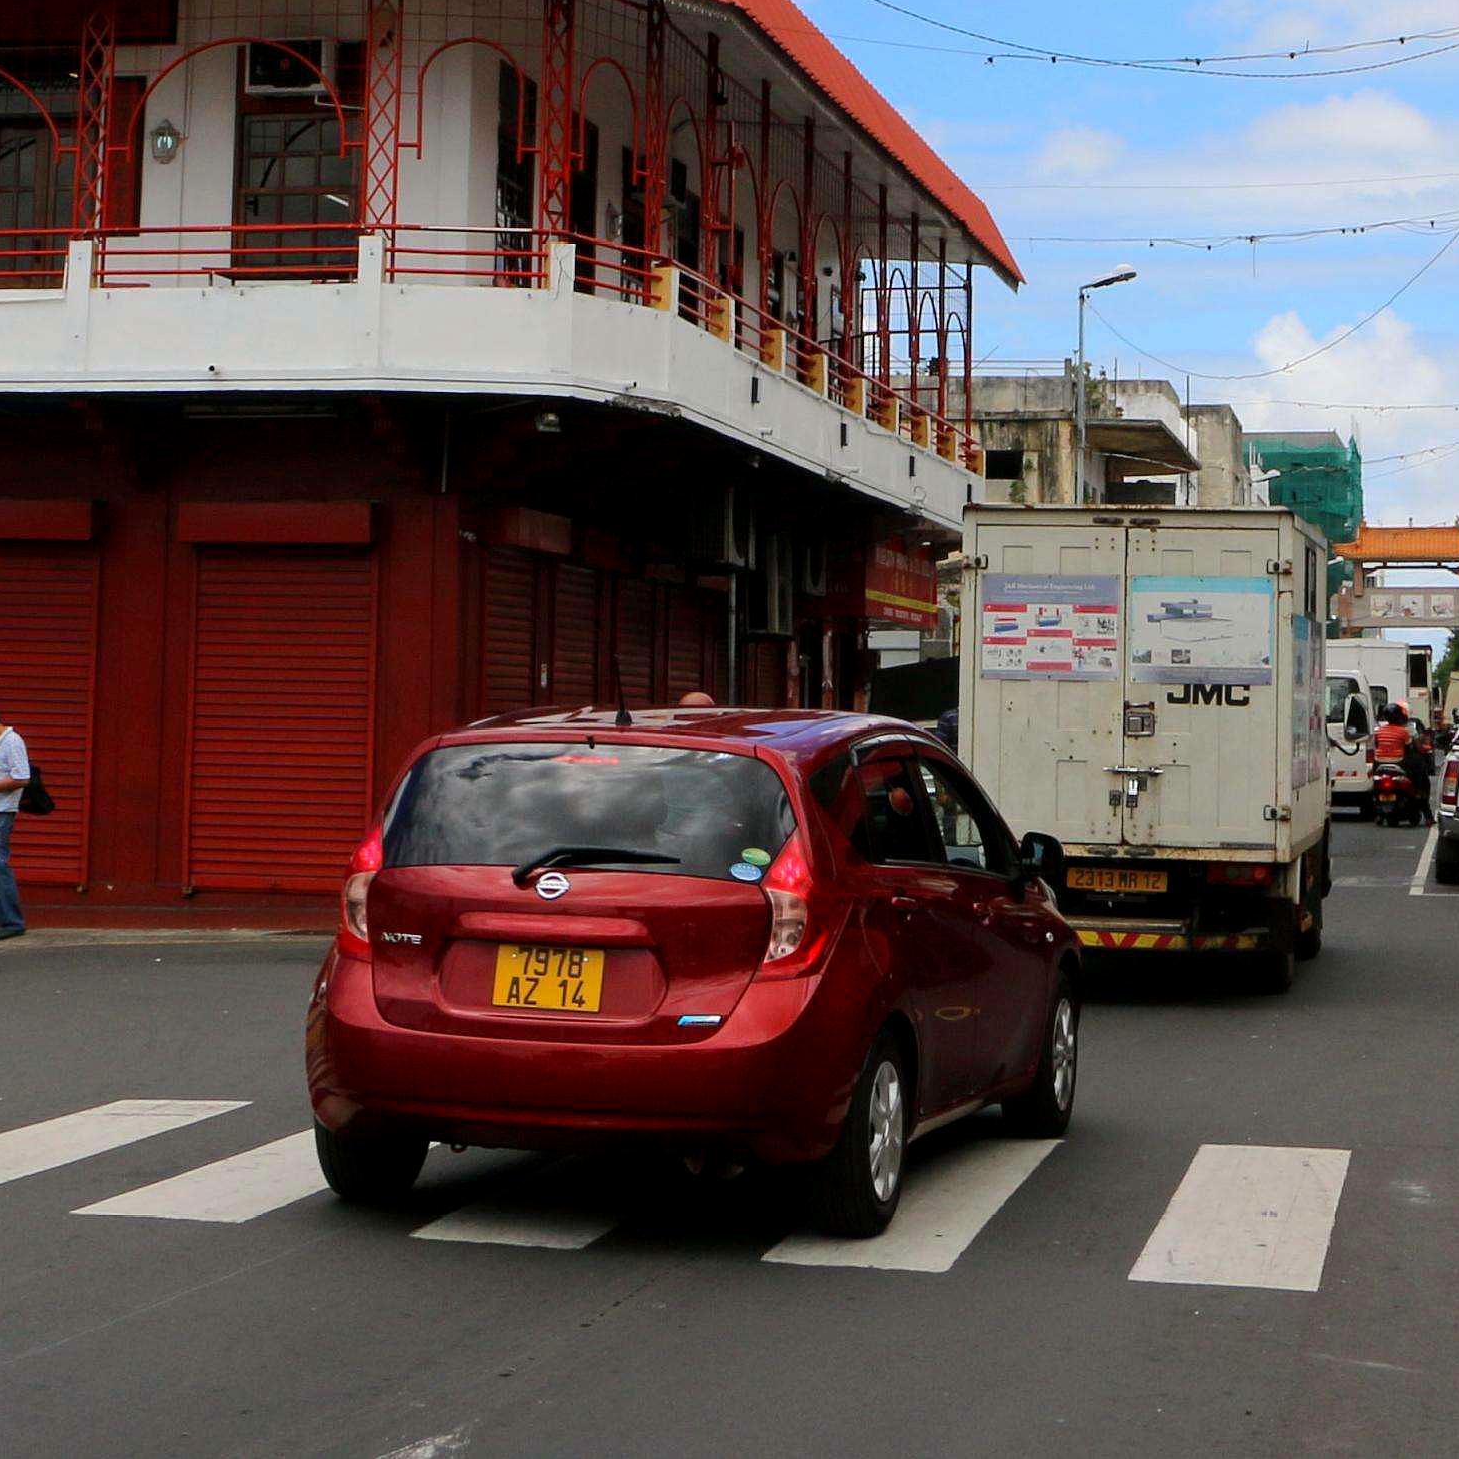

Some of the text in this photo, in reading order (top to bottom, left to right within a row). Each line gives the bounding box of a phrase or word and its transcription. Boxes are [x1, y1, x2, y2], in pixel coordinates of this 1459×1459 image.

[1166, 684, 1251, 707] JMC
[381, 931, 422, 945] NOTE
[519, 946, 584, 979] 7978
[507, 977, 585, 1008] AZ 14
